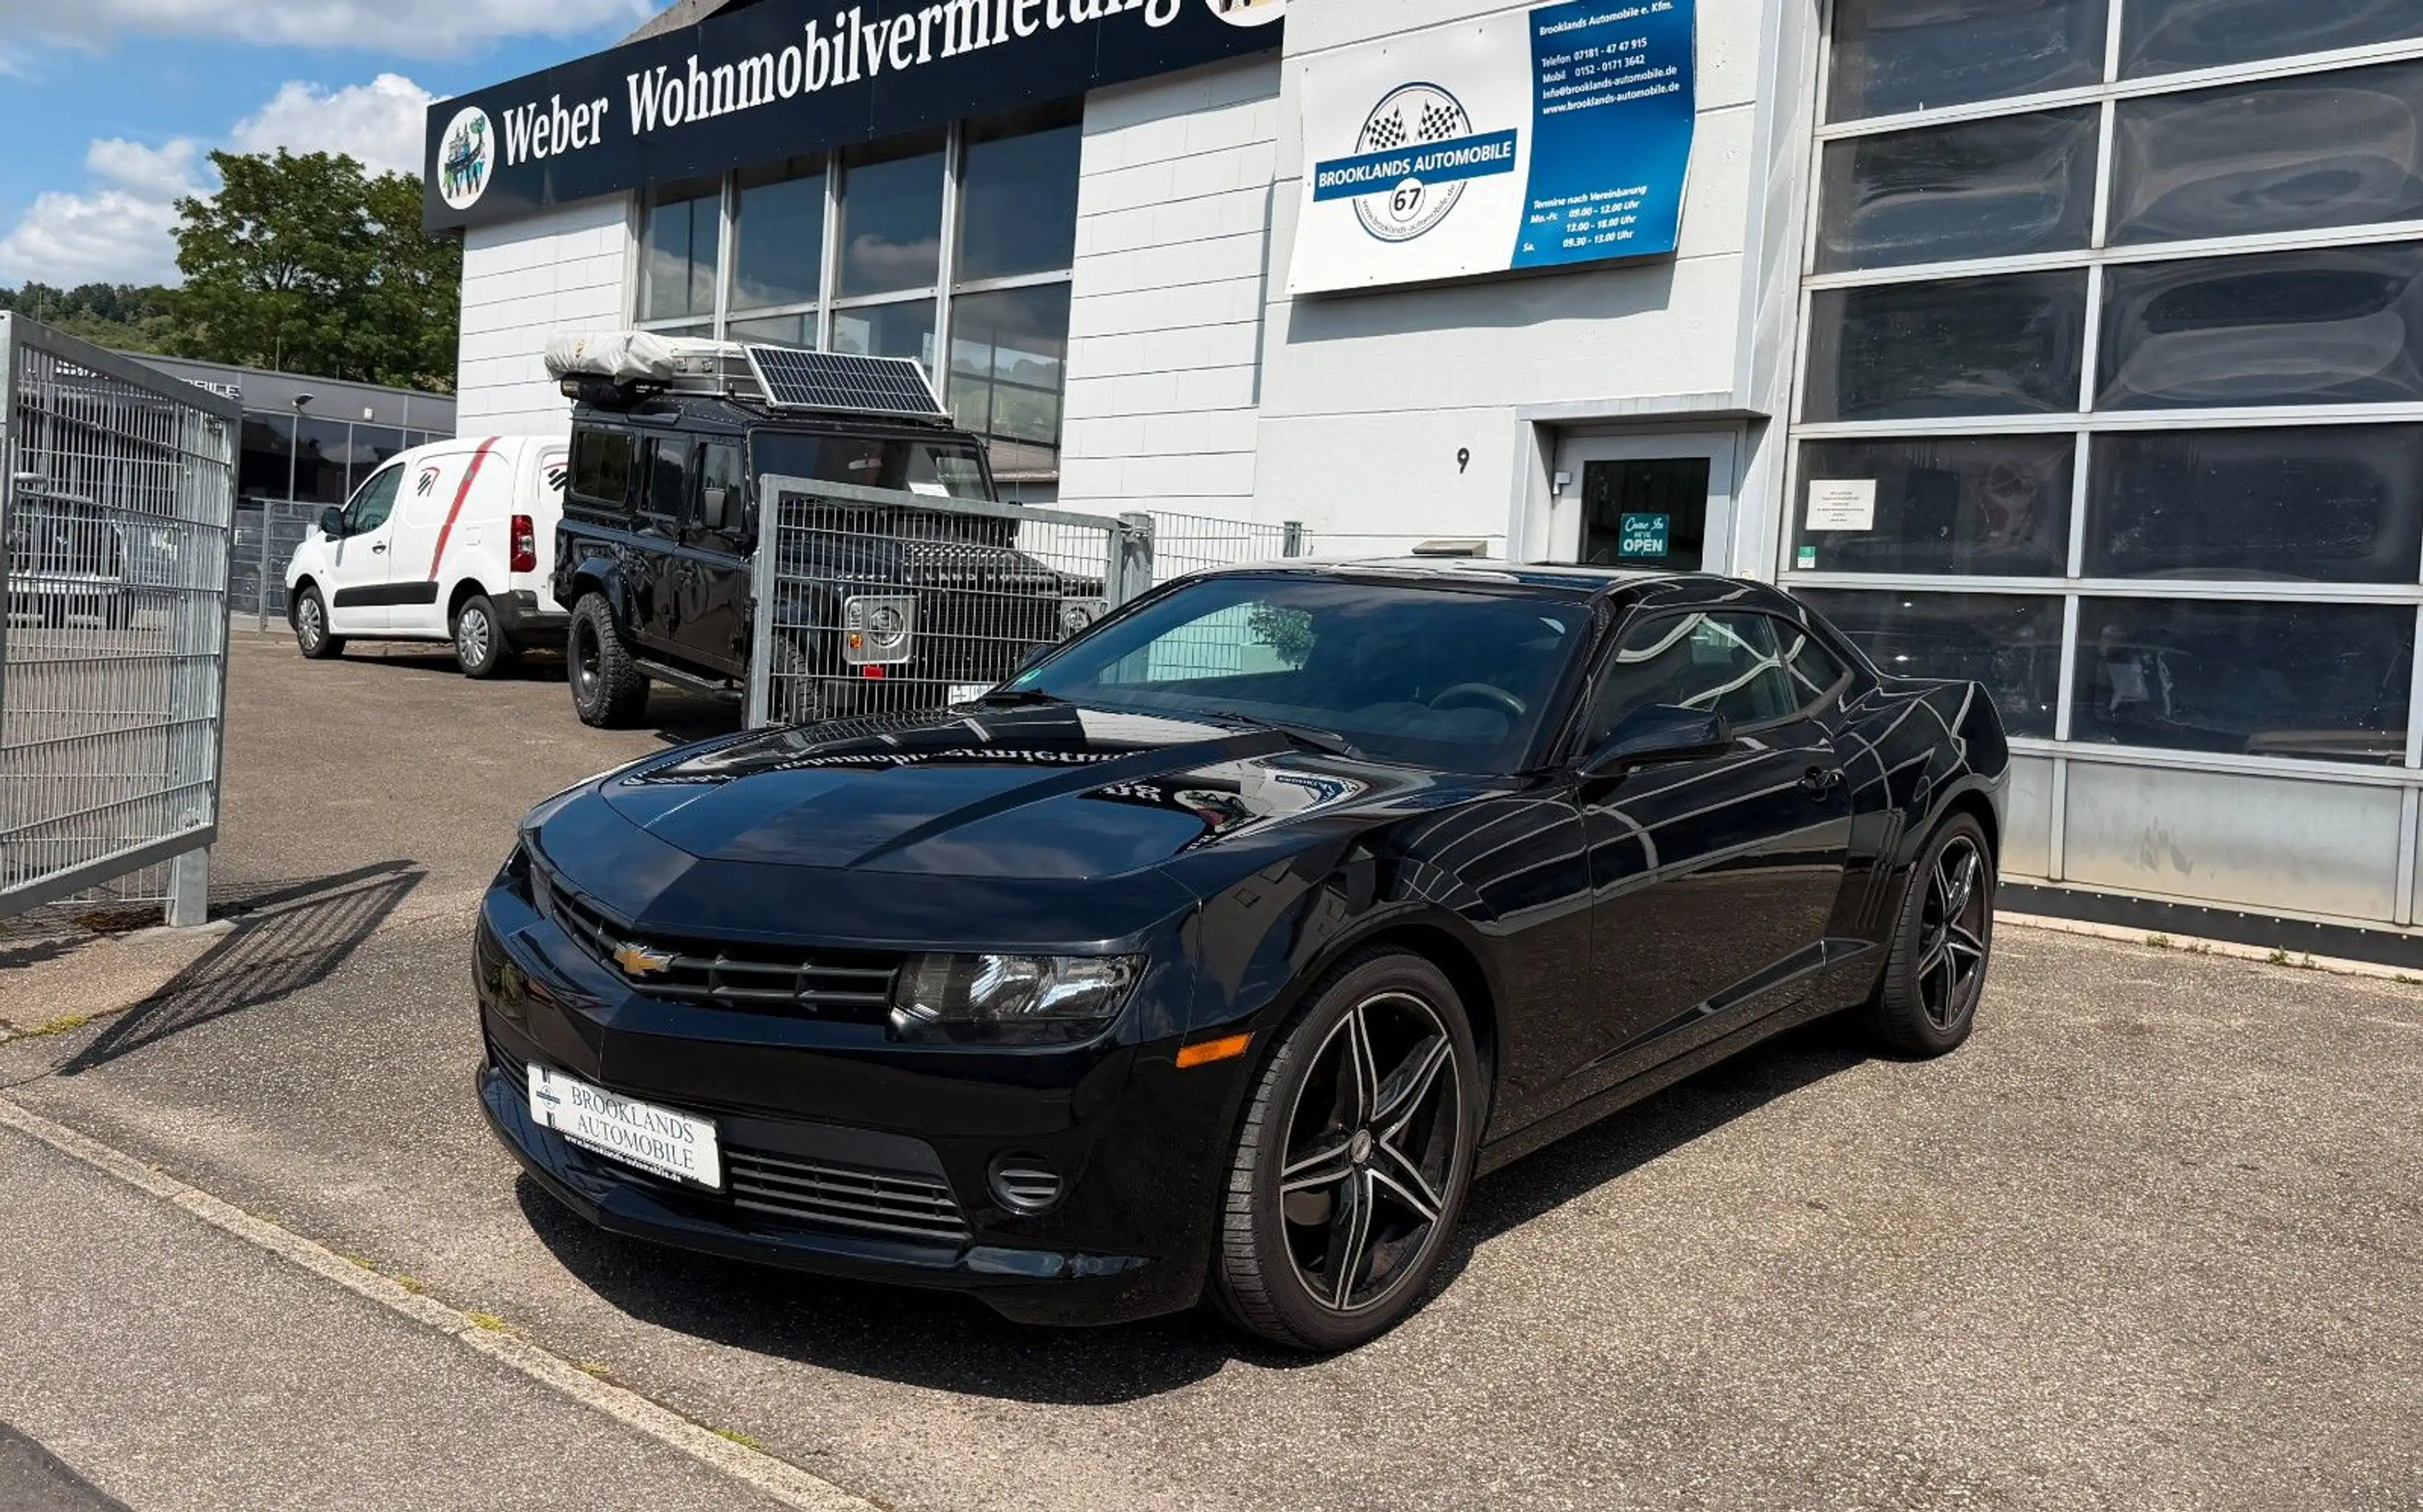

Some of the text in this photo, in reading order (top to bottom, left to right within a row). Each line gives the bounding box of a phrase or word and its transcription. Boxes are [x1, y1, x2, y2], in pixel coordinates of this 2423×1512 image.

[1540, 18, 1587, 36] Brooklands
[1589, 6, 1639, 25] Automobile
[1542, 54, 1571, 67] Telefon
[1573, 47, 1598, 61] 07181
[1605, 44, 1616, 54] 47
[1630, 37, 1648, 49] 915
[1543, 69, 1566, 84] Mobil
[1575, 65, 1595, 76] 0152
[1602, 59, 1622, 71] 0171
[1625, 55, 1645, 67] 3642
[1543, 82, 1680, 114] www.brooklands-automobile.de
[502, 95, 609, 166] Weber
[1319, 141, 1512, 188] BROOKLANDS AUTOMOBILE
[1394, 188, 1421, 211] 67
[1533, 185, 1648, 209] Termine nach Vereinbarung
[1624, 200, 1641, 211] Uhr
[1620, 215, 1637, 225] Uhr
[1617, 230, 1634, 240] Uhr
[1457, 447, 1470, 474] 9
[1625, 517, 1649, 532] Come
[1624, 539, 1663, 552] OPEN
[571, 1086, 694, 1144] BROOKLANDS
[578, 1115, 694, 1170] AUTOMOBILE
